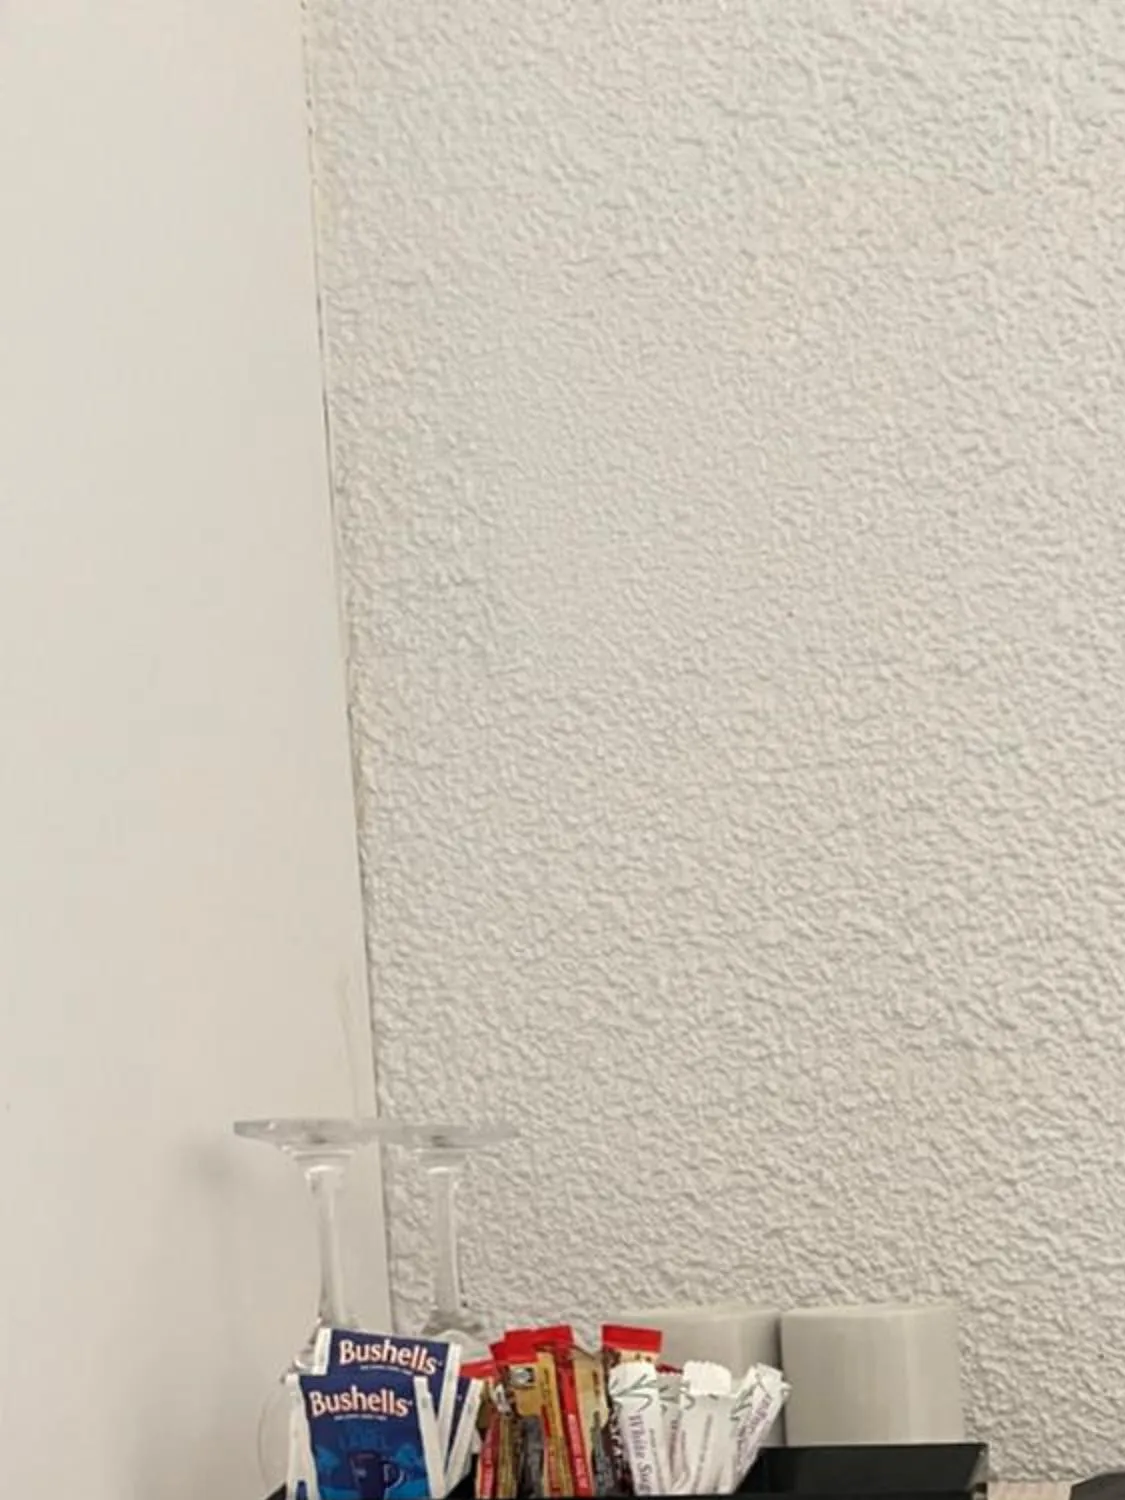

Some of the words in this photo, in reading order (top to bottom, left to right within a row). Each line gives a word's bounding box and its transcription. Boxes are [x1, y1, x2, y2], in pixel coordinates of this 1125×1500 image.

[338, 1338, 438, 1375] Bushells
[309, 1384, 410, 1418] Bushells
[628, 1412, 648, 1460] White
